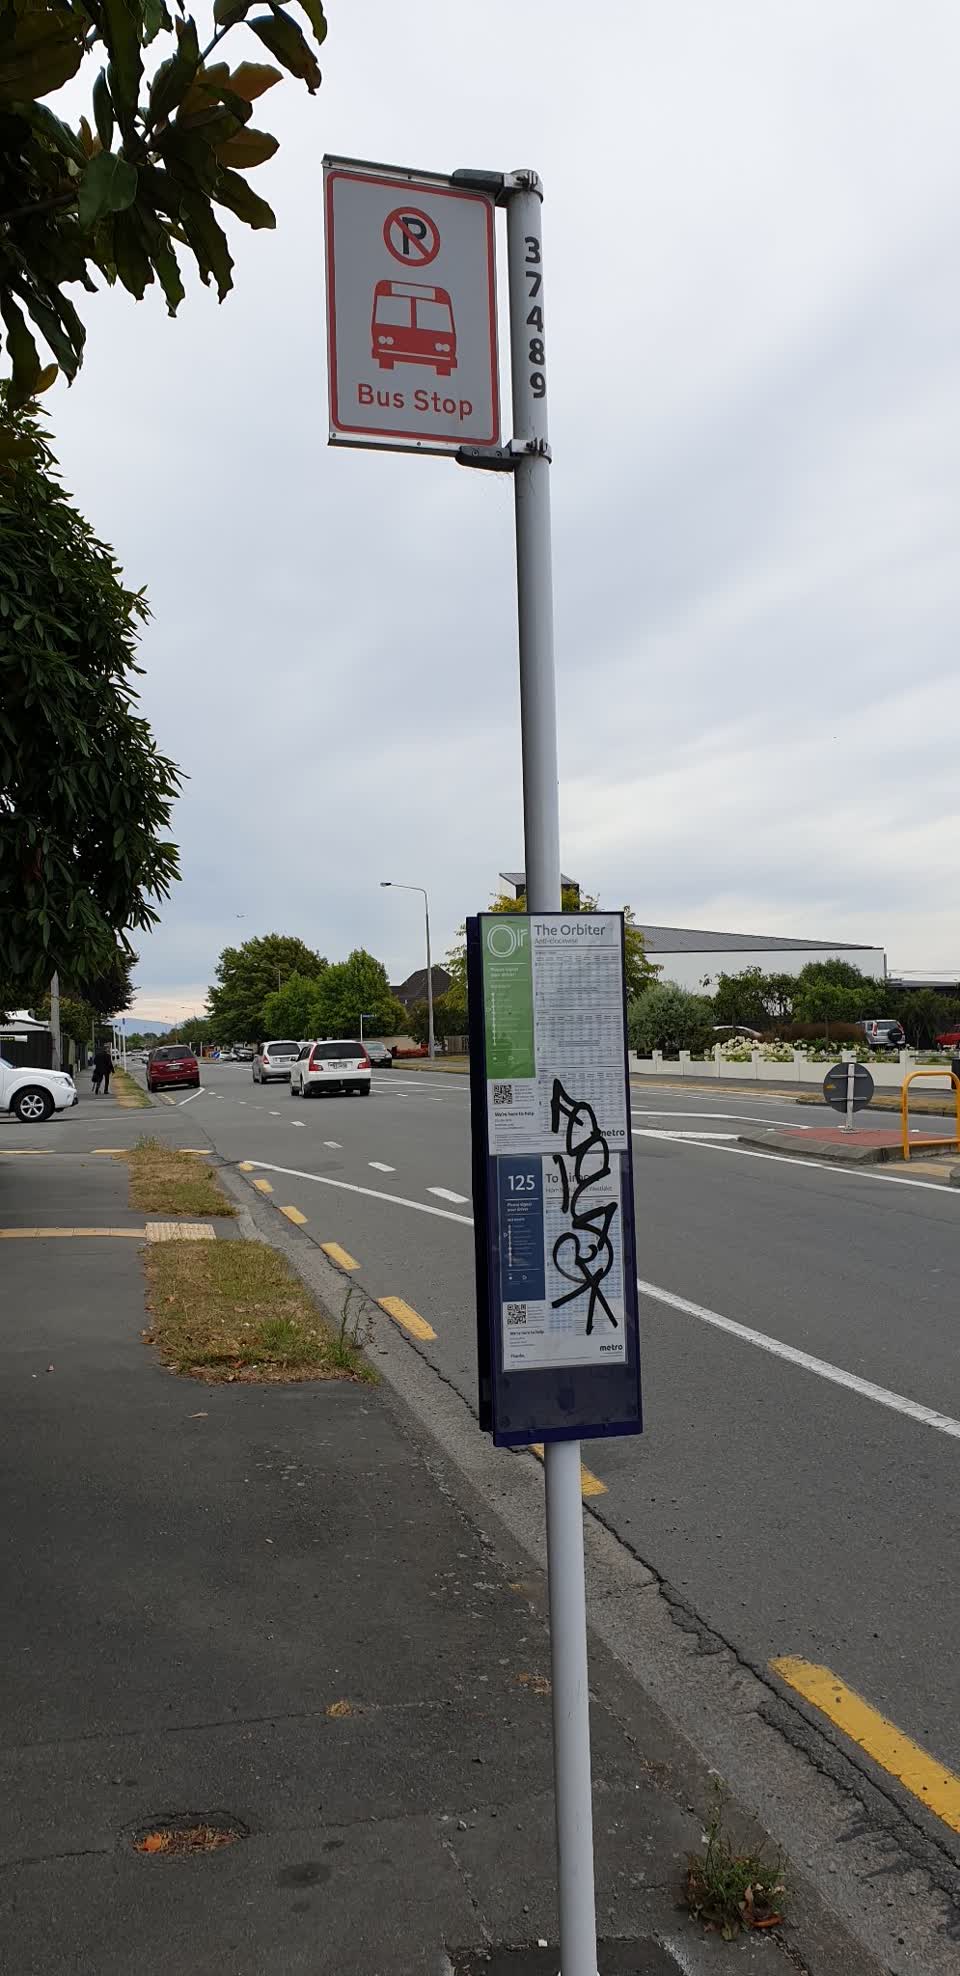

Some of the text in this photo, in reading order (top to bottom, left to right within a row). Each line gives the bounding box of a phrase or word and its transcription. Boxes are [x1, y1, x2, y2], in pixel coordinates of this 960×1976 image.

[402, 216, 427, 255] P
[524, 236, 546, 398] 37489
[357, 384, 474, 421] Bus Stop
[487, 924, 528, 958] Or
[534, 923, 606, 936] The Orbiter
[508, 1174, 536, 1191] 125
[545, 1173, 559, 1183] To
[599, 1344, 623, 1352] metro
